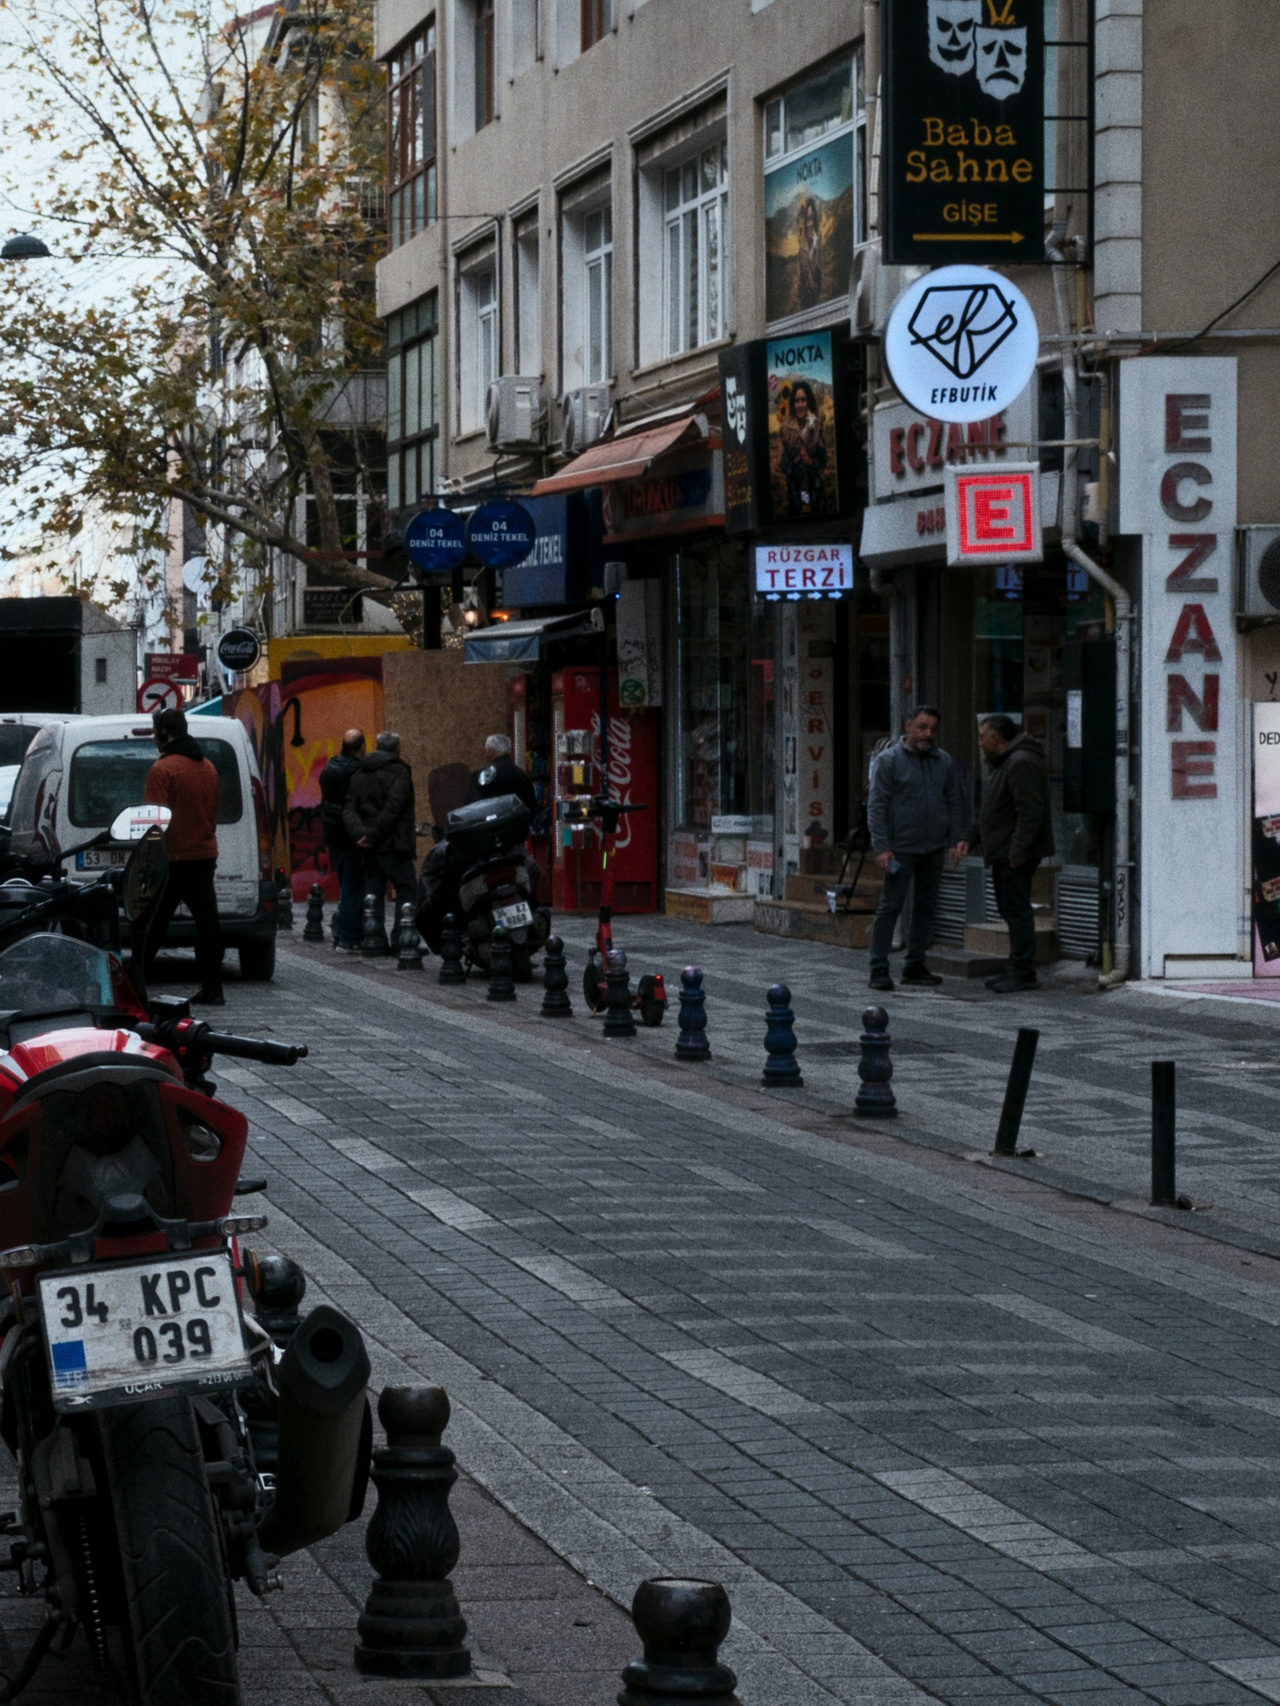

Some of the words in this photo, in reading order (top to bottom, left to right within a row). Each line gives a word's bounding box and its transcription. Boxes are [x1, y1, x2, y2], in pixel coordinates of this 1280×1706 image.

[922, 116, 1017, 147] Baba
[905, 150, 1034, 183] Sahne
[942, 199, 999, 227] GİŞE
[774, 343, 825, 369] NOKTA
[930, 382, 998, 404] EFBUTİK
[428, 527, 445, 539] 04
[470, 531, 499, 542] DENİZ
[500, 532, 530, 542] TEKEL
[491, 520, 508, 532] 04
[409, 538, 435, 548] DENİZ
[437, 539, 464, 548] TEKEL
[767, 546, 841, 563] RÜZGAR
[765, 562, 845, 589] TERZİ
[1159, 393, 1223, 800] ECZANE
[1259, 731, 1280, 746] DED
[85, 851, 101, 865] 53
[56, 1283, 109, 1328] 34
[139, 1266, 221, 1317] KPC
[132, 1318, 213, 1367] 039
